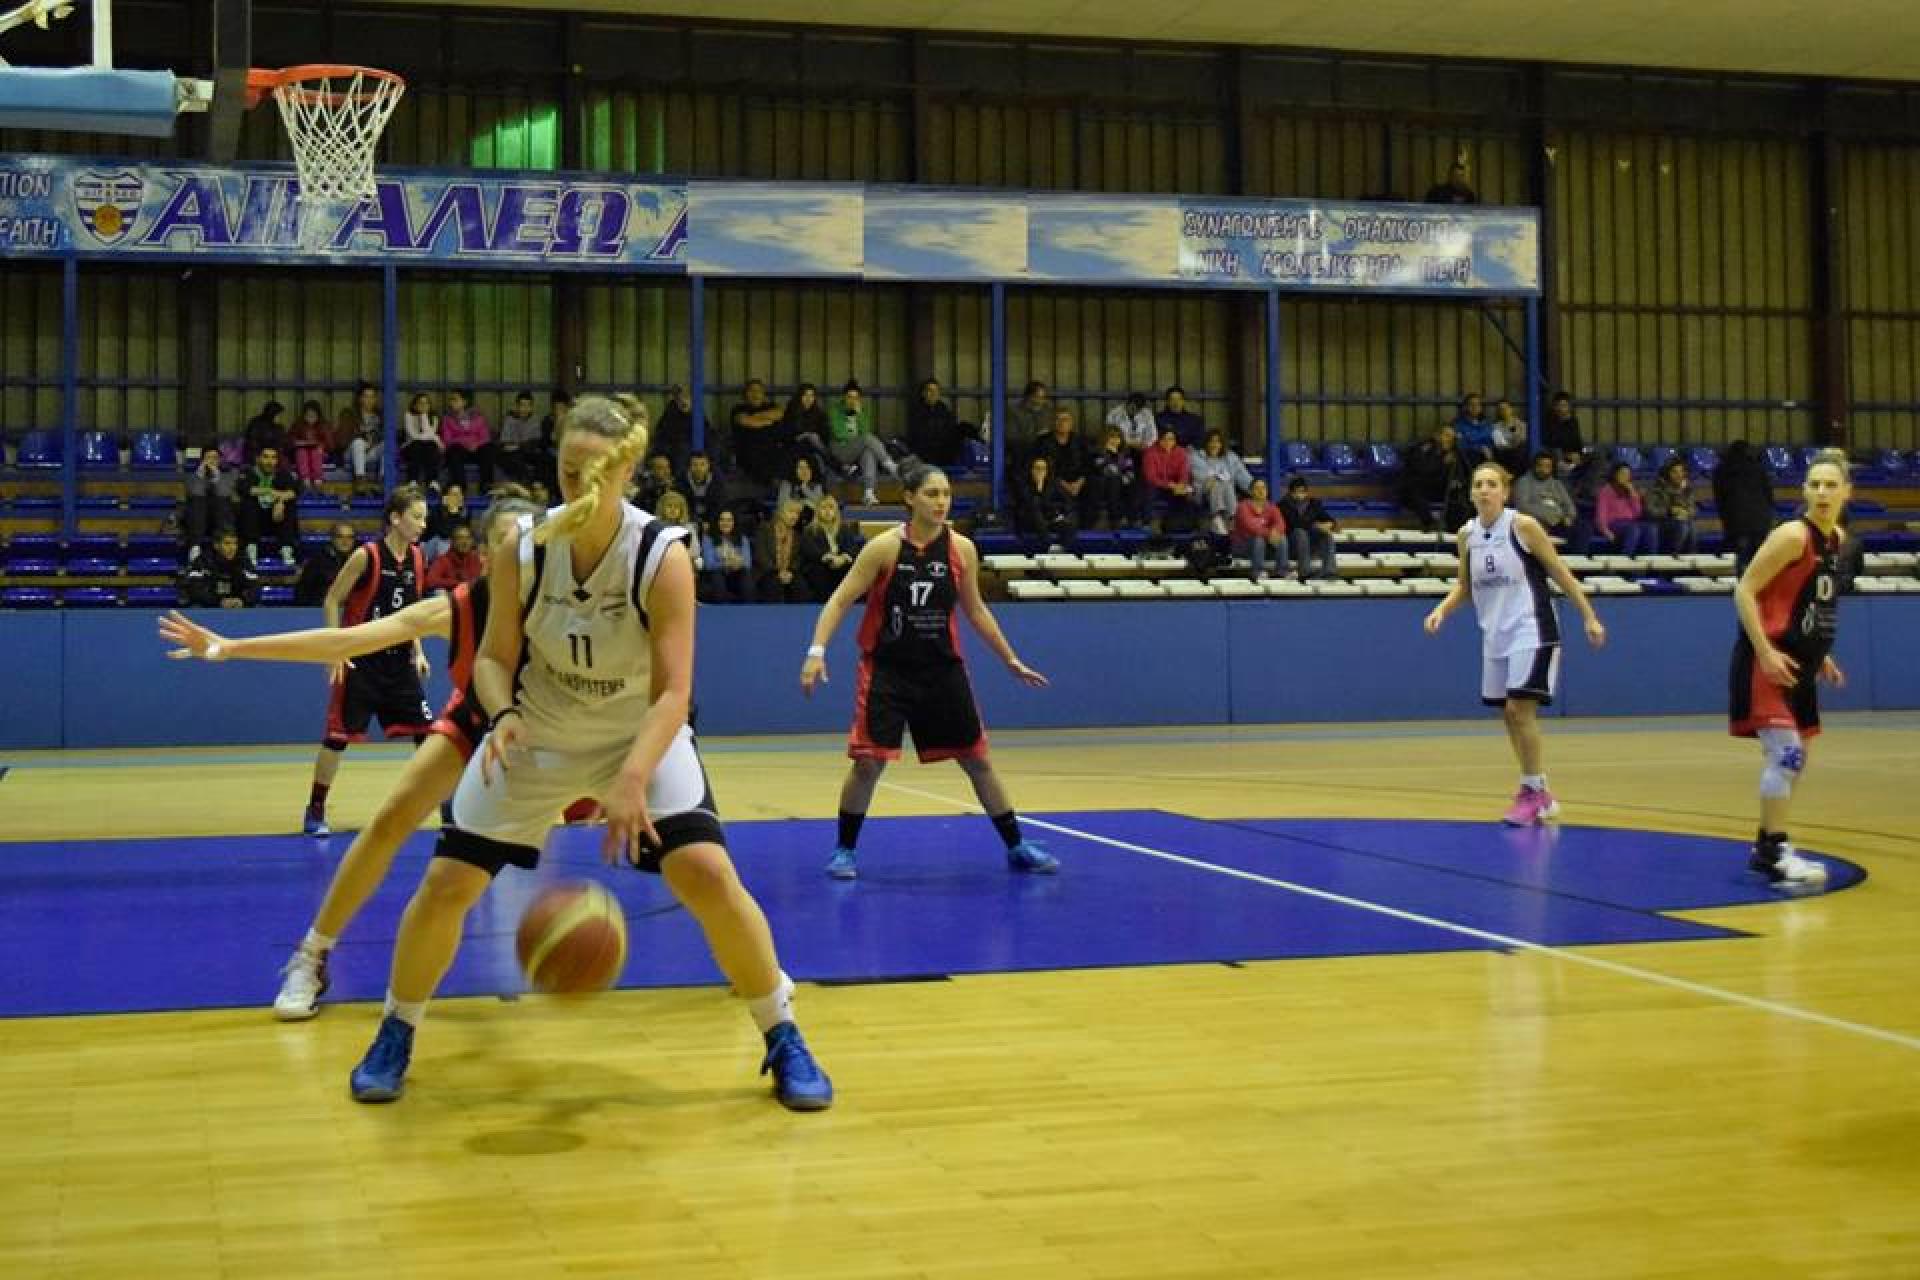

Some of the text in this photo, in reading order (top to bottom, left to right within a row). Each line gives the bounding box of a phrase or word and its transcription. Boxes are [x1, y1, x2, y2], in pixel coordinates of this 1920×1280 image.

[391, 587, 405, 608] 5
[909, 581, 935, 607] 17
[1816, 575, 1833, 601] 0
[567, 633, 593, 669] 11
